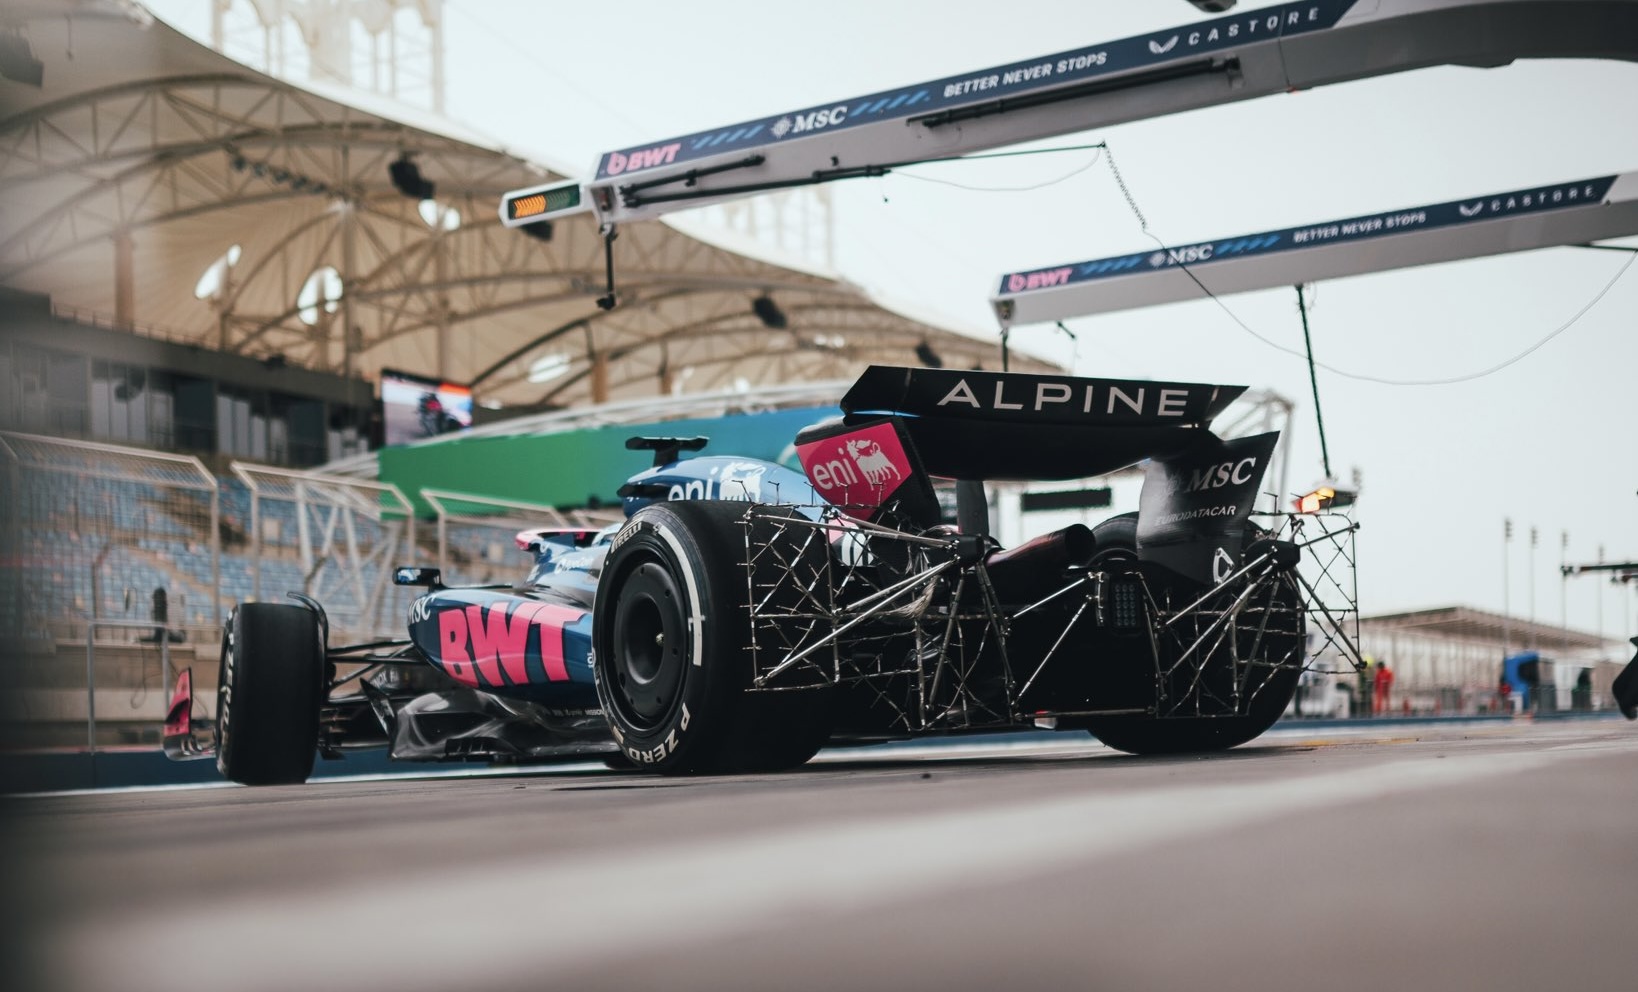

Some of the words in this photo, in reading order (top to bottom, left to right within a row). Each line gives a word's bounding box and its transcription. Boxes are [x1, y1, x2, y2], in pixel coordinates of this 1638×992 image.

[626, 143, 680, 169] BWT
[791, 106, 848, 133] MSC
[943, 75, 999, 98] BETTER
[1002, 63, 1053, 86] NEVER
[1056, 51, 1107, 74] STOPS
[1188, 7, 1319, 46] CASTORE
[1026, 268, 1073, 289] BWT
[1167, 244, 1214, 266] MSC
[1293, 223, 1339, 243] BETTER
[1341, 218, 1383, 237] NEVER
[1386, 211, 1427, 229] STOPS
[1490, 185, 1595, 211] CASTORE
[937, 378, 1190, 417] ALPINE
[667, 466, 719, 502] eni
[813, 447, 858, 491] eni
[1182, 457, 1256, 493] MSC
[1155, 505, 1236, 526] EURODATACAR
[439, 601, 587, 689] BWT
[681, 702, 690, 731] P
[629, 728, 679, 763] ZERO
